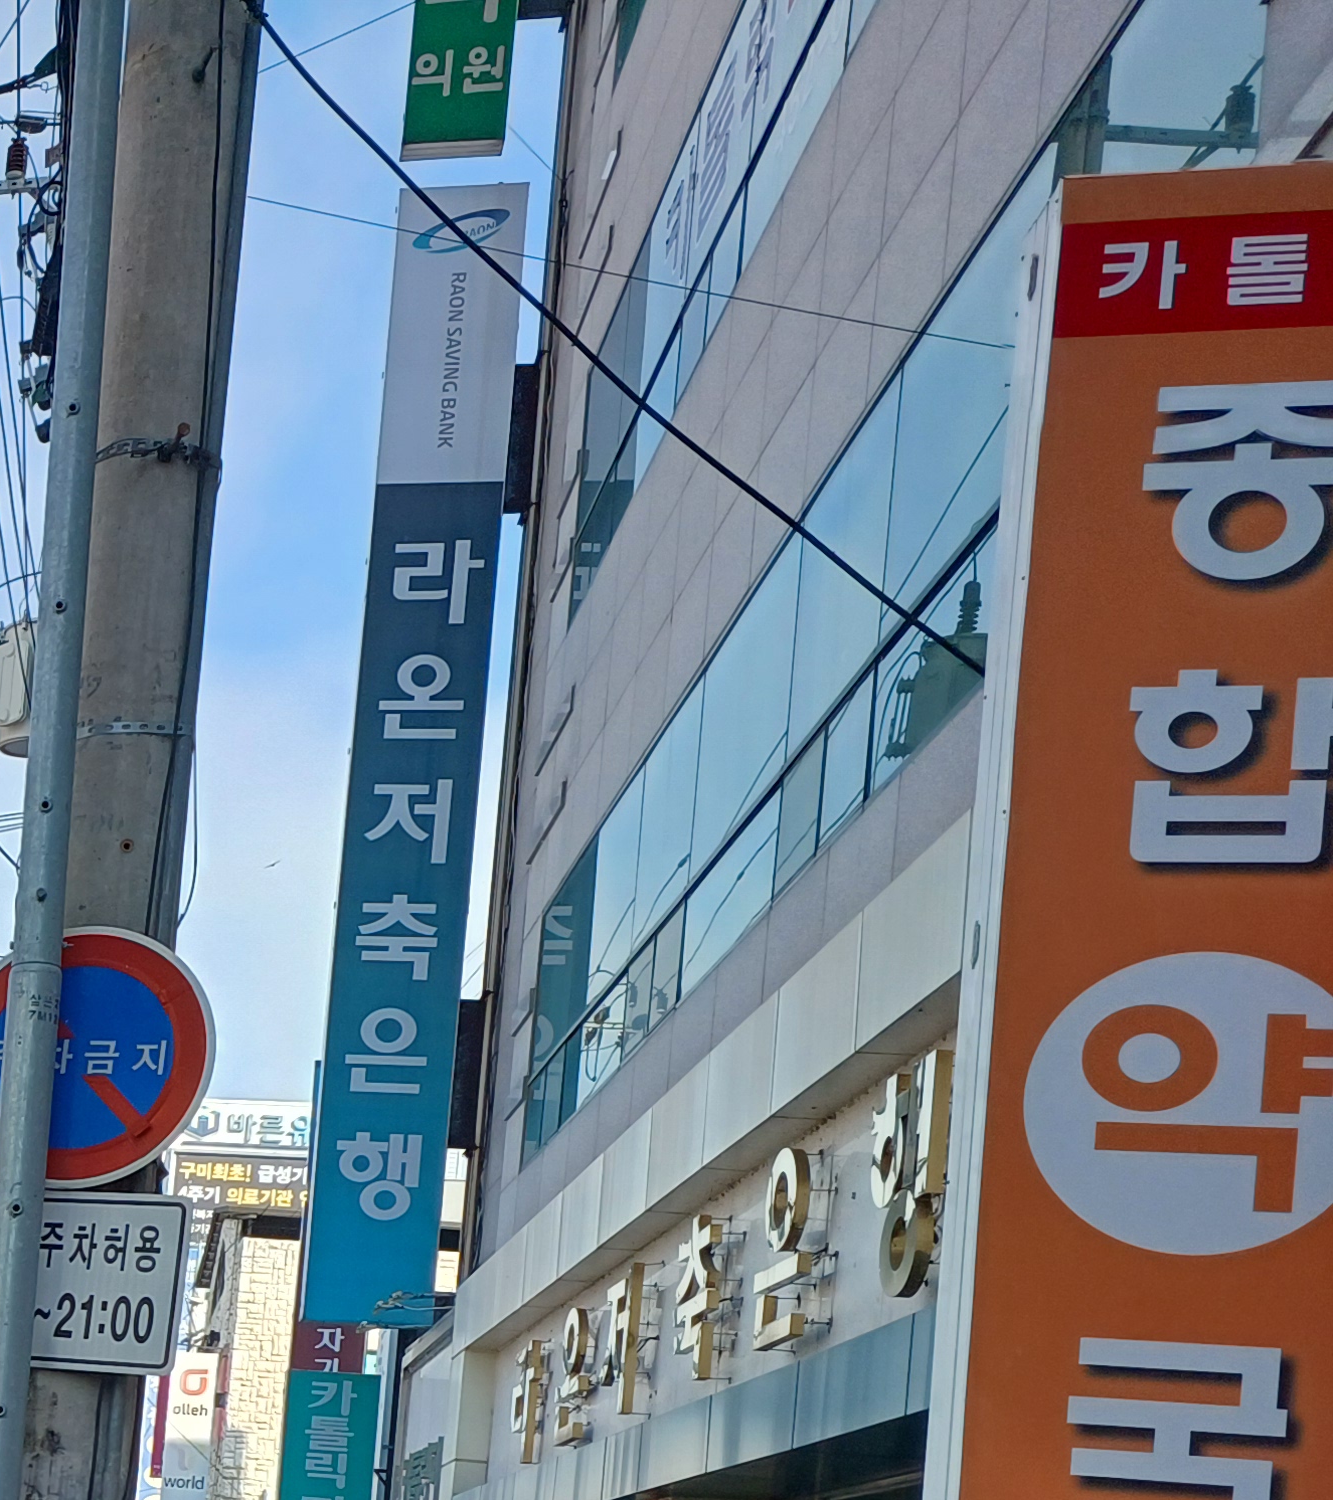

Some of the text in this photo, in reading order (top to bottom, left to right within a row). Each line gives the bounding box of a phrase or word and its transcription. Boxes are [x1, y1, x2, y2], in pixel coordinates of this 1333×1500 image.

[411, 46, 505, 97] 의원
[1098, 233, 1309, 310] 카톨
[436, 271, 467, 449] RAON SAVING BANK
[336, 539, 485, 1221] 라온저축은행
[225, 1186, 294, 1208] 의료기관
[511, 1050, 949, 1465] 라온저축은행
[172, 1404, 209, 1417] olleh
[163, 1475, 205, 1491] world
